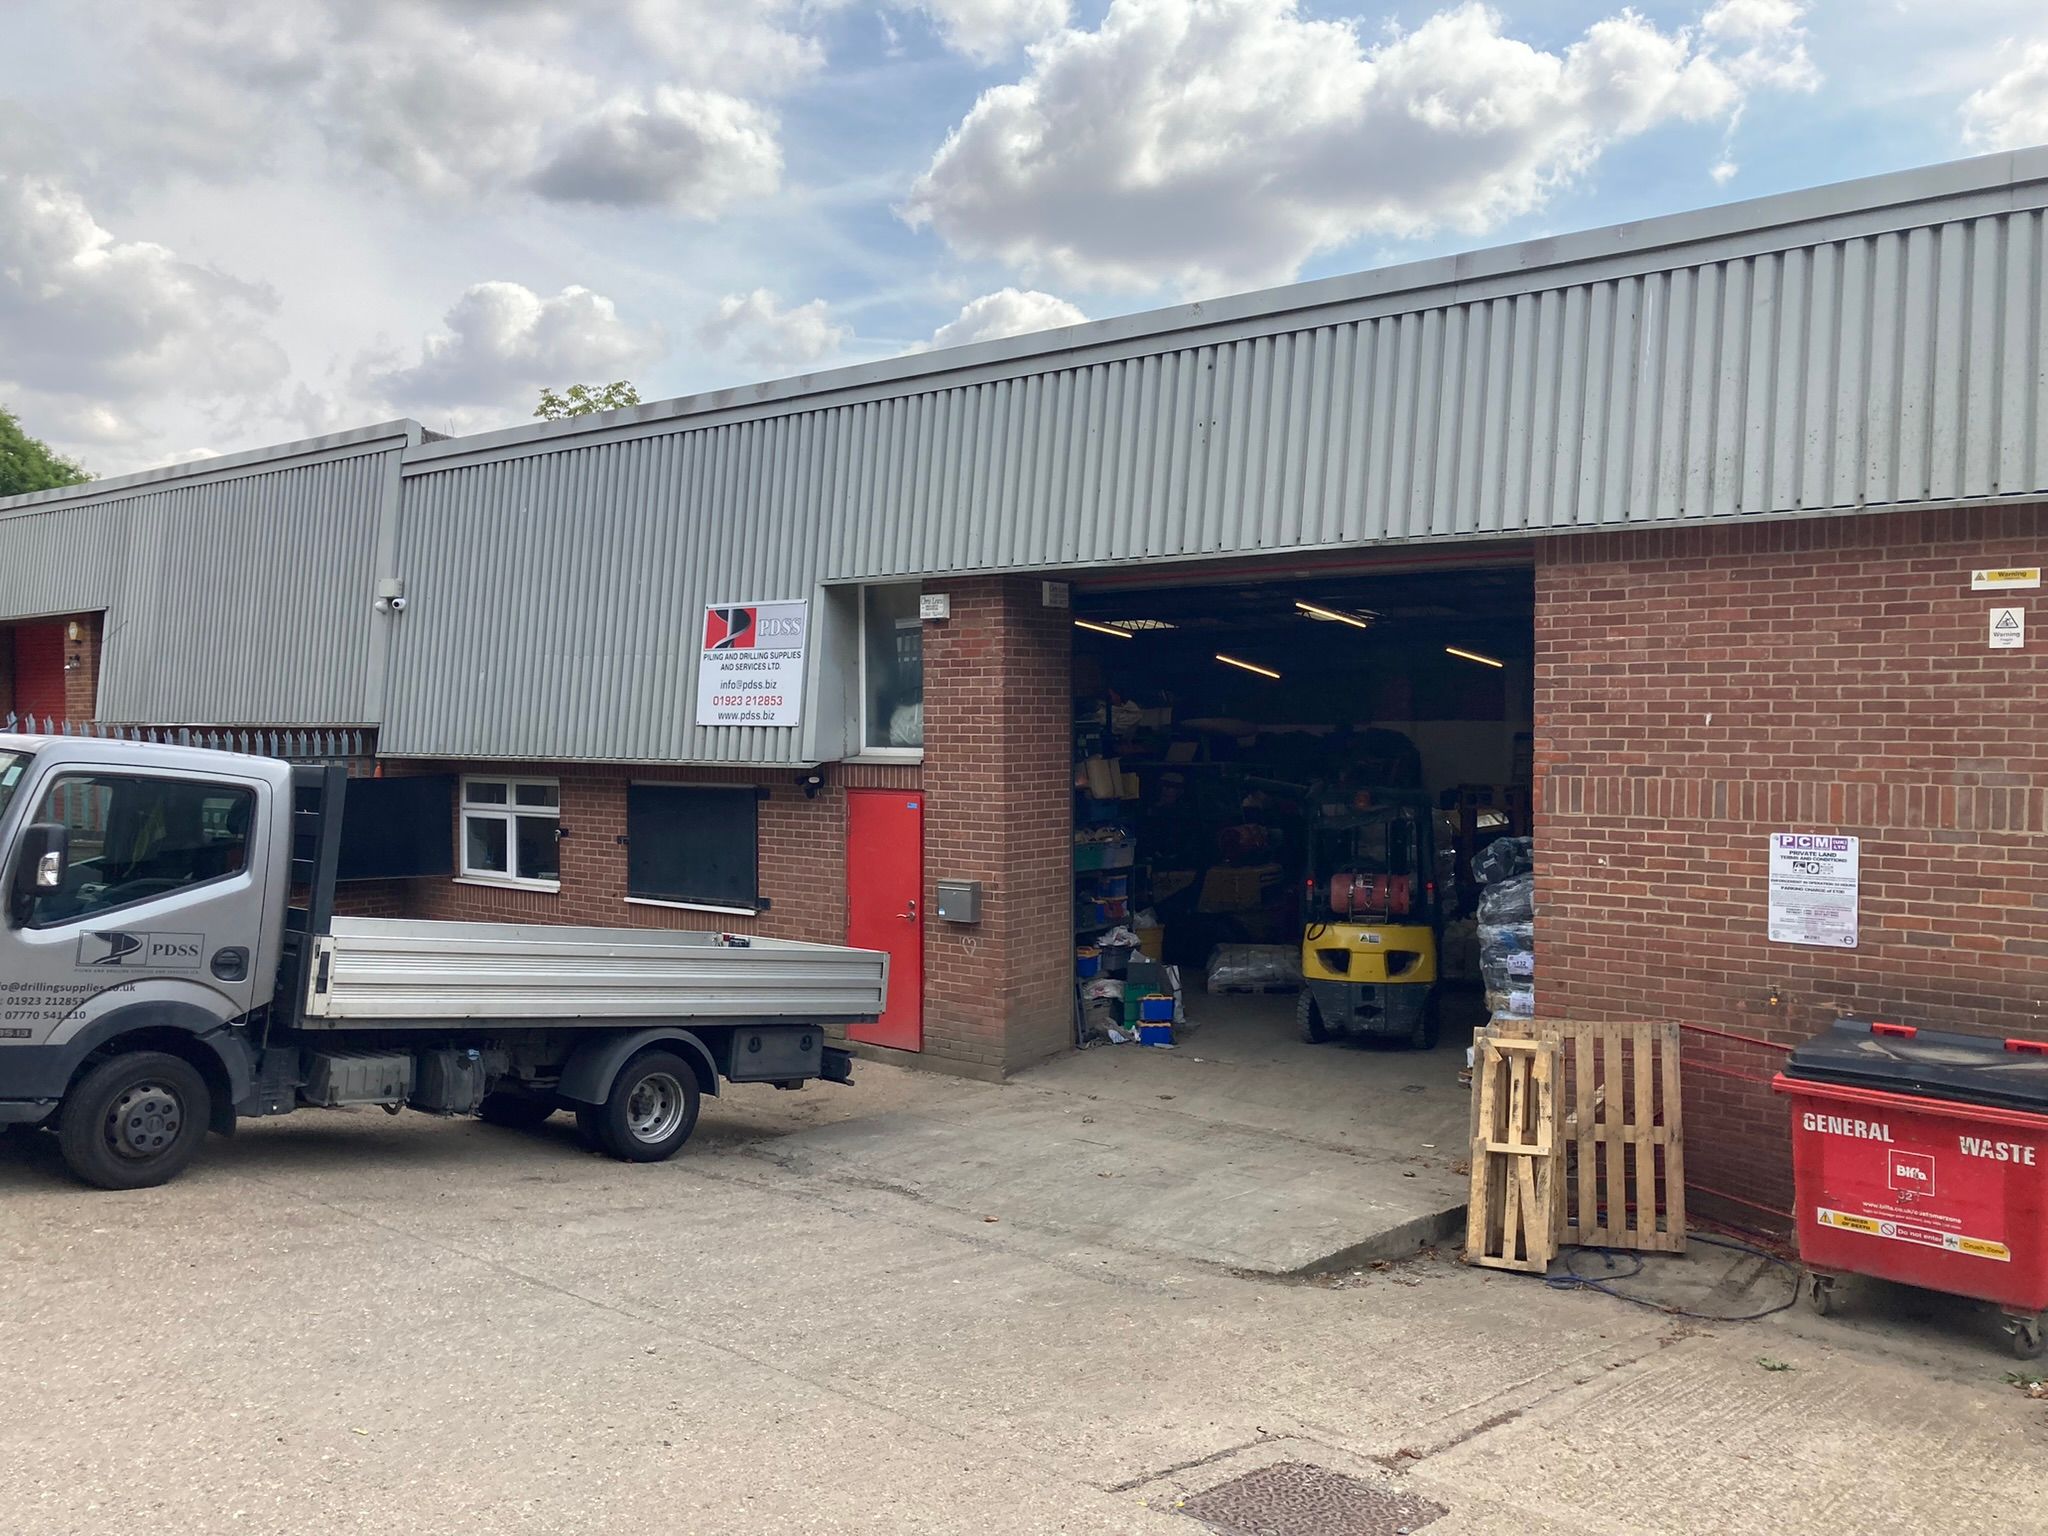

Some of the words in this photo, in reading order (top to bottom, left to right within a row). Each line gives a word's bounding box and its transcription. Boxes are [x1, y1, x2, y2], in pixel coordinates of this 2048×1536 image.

[758, 617, 802, 636] PDSS
[703, 653, 723, 661] PILING
[724, 652, 738, 660] AND
[739, 652, 769, 660] DRILLING
[769, 651, 802, 659] SUPPLIES
[720, 663, 734, 671] AND
[735, 662, 767, 671] SERVICES
[720, 680, 777, 691] info@pdss.biz
[712, 696, 743, 706] 01923
[745, 695, 783, 706] 212853
[717, 710, 775, 722] www.pdss.biz
[152, 943, 199, 957] PDSS
[7, 996, 41, 1006] 01923
[5, 1011, 40, 1020] 07770
[1803, 1112, 1894, 1143] GENERAL
[1959, 1136, 2036, 1166] WASTE
[1897, 1228, 1909, 1236] Do
[1909, 1230, 1922, 1238] not
[1923, 1233, 1943, 1243] enter
[1963, 1242, 1985, 1252] Crush
